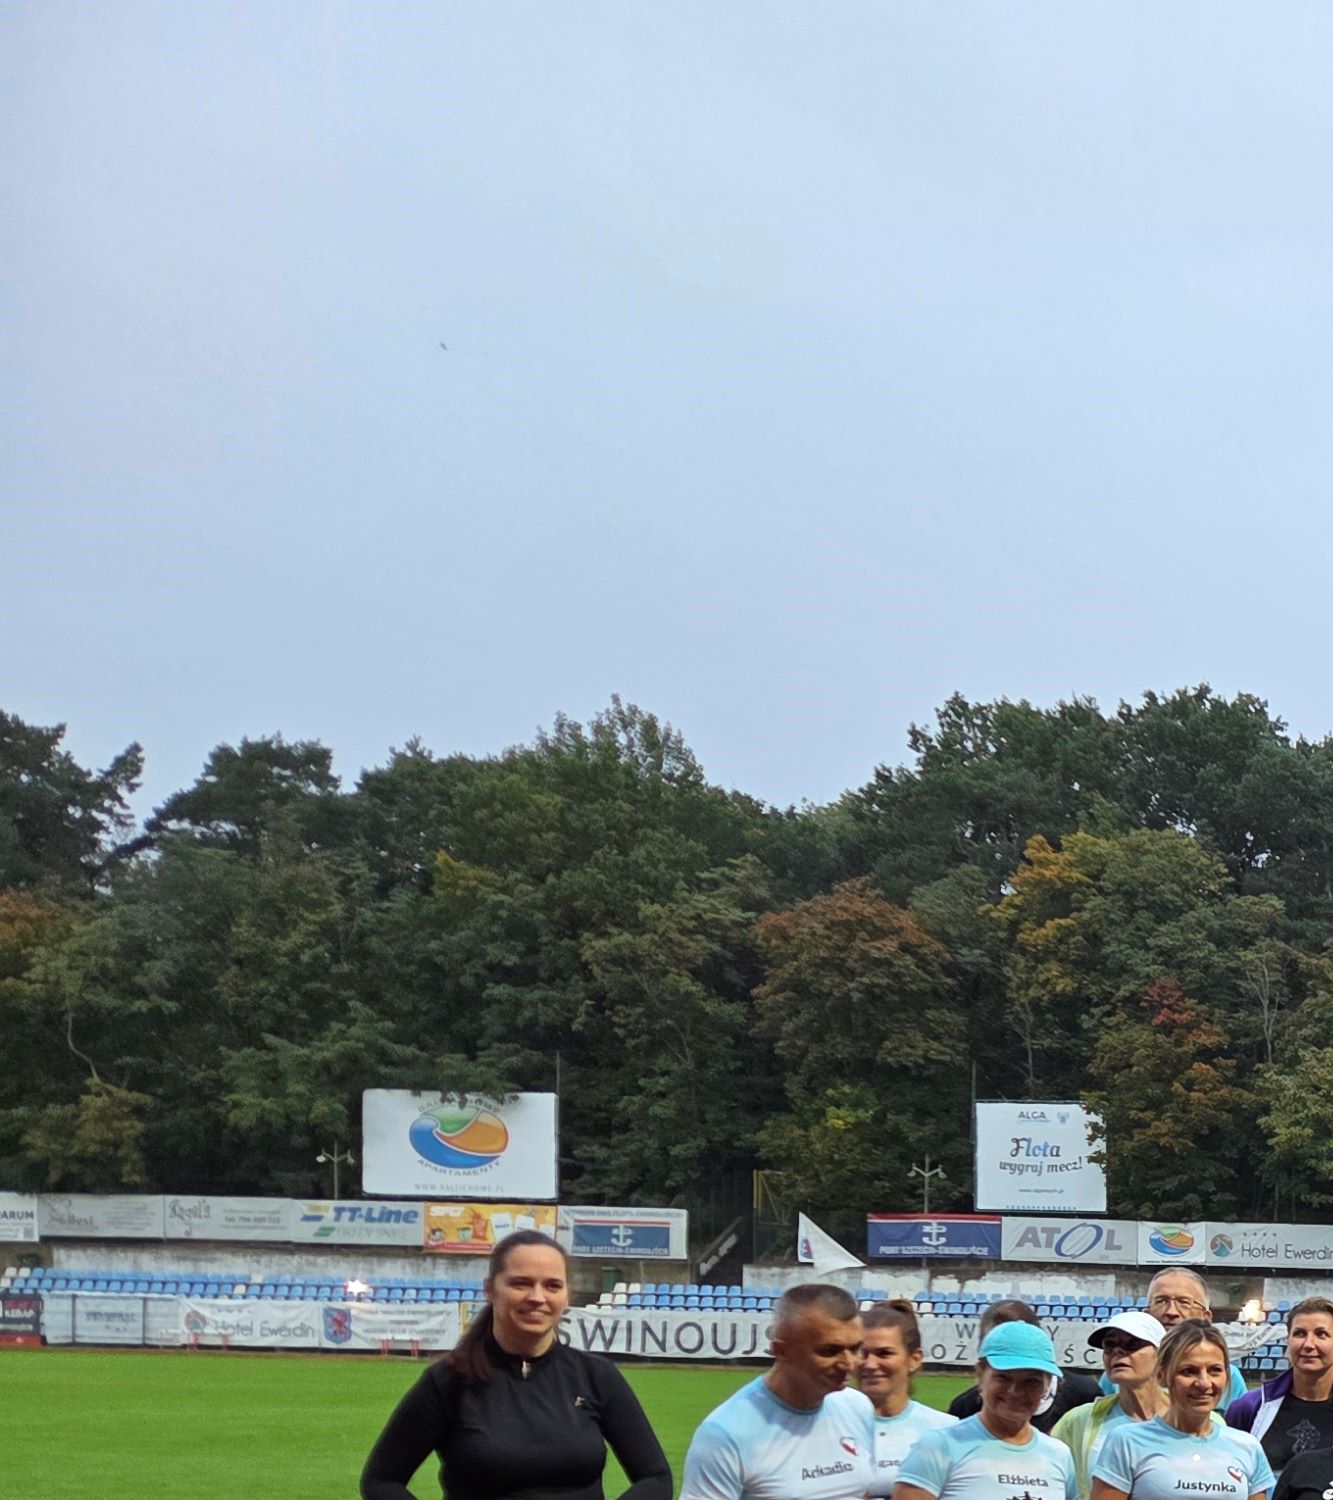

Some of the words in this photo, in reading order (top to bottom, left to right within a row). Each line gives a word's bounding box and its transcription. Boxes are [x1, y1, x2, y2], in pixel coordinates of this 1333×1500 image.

[1010, 1137, 1061, 1158] Flota
[416, 1159, 501, 1177] APARTAMENTY
[999, 1160, 1043, 1176] wygraj
[1046, 1156, 1082, 1173] mecz!
[333, 1206, 419, 1224] TT-Line
[1015, 1222, 1122, 1259] ATOL
[1241, 1242, 1278, 1259] Hotel
[215, 1320, 254, 1336] Hotel
[997, 1473, 1049, 1487] Elżbieta
[1173, 1478, 1237, 1494] Justynka
